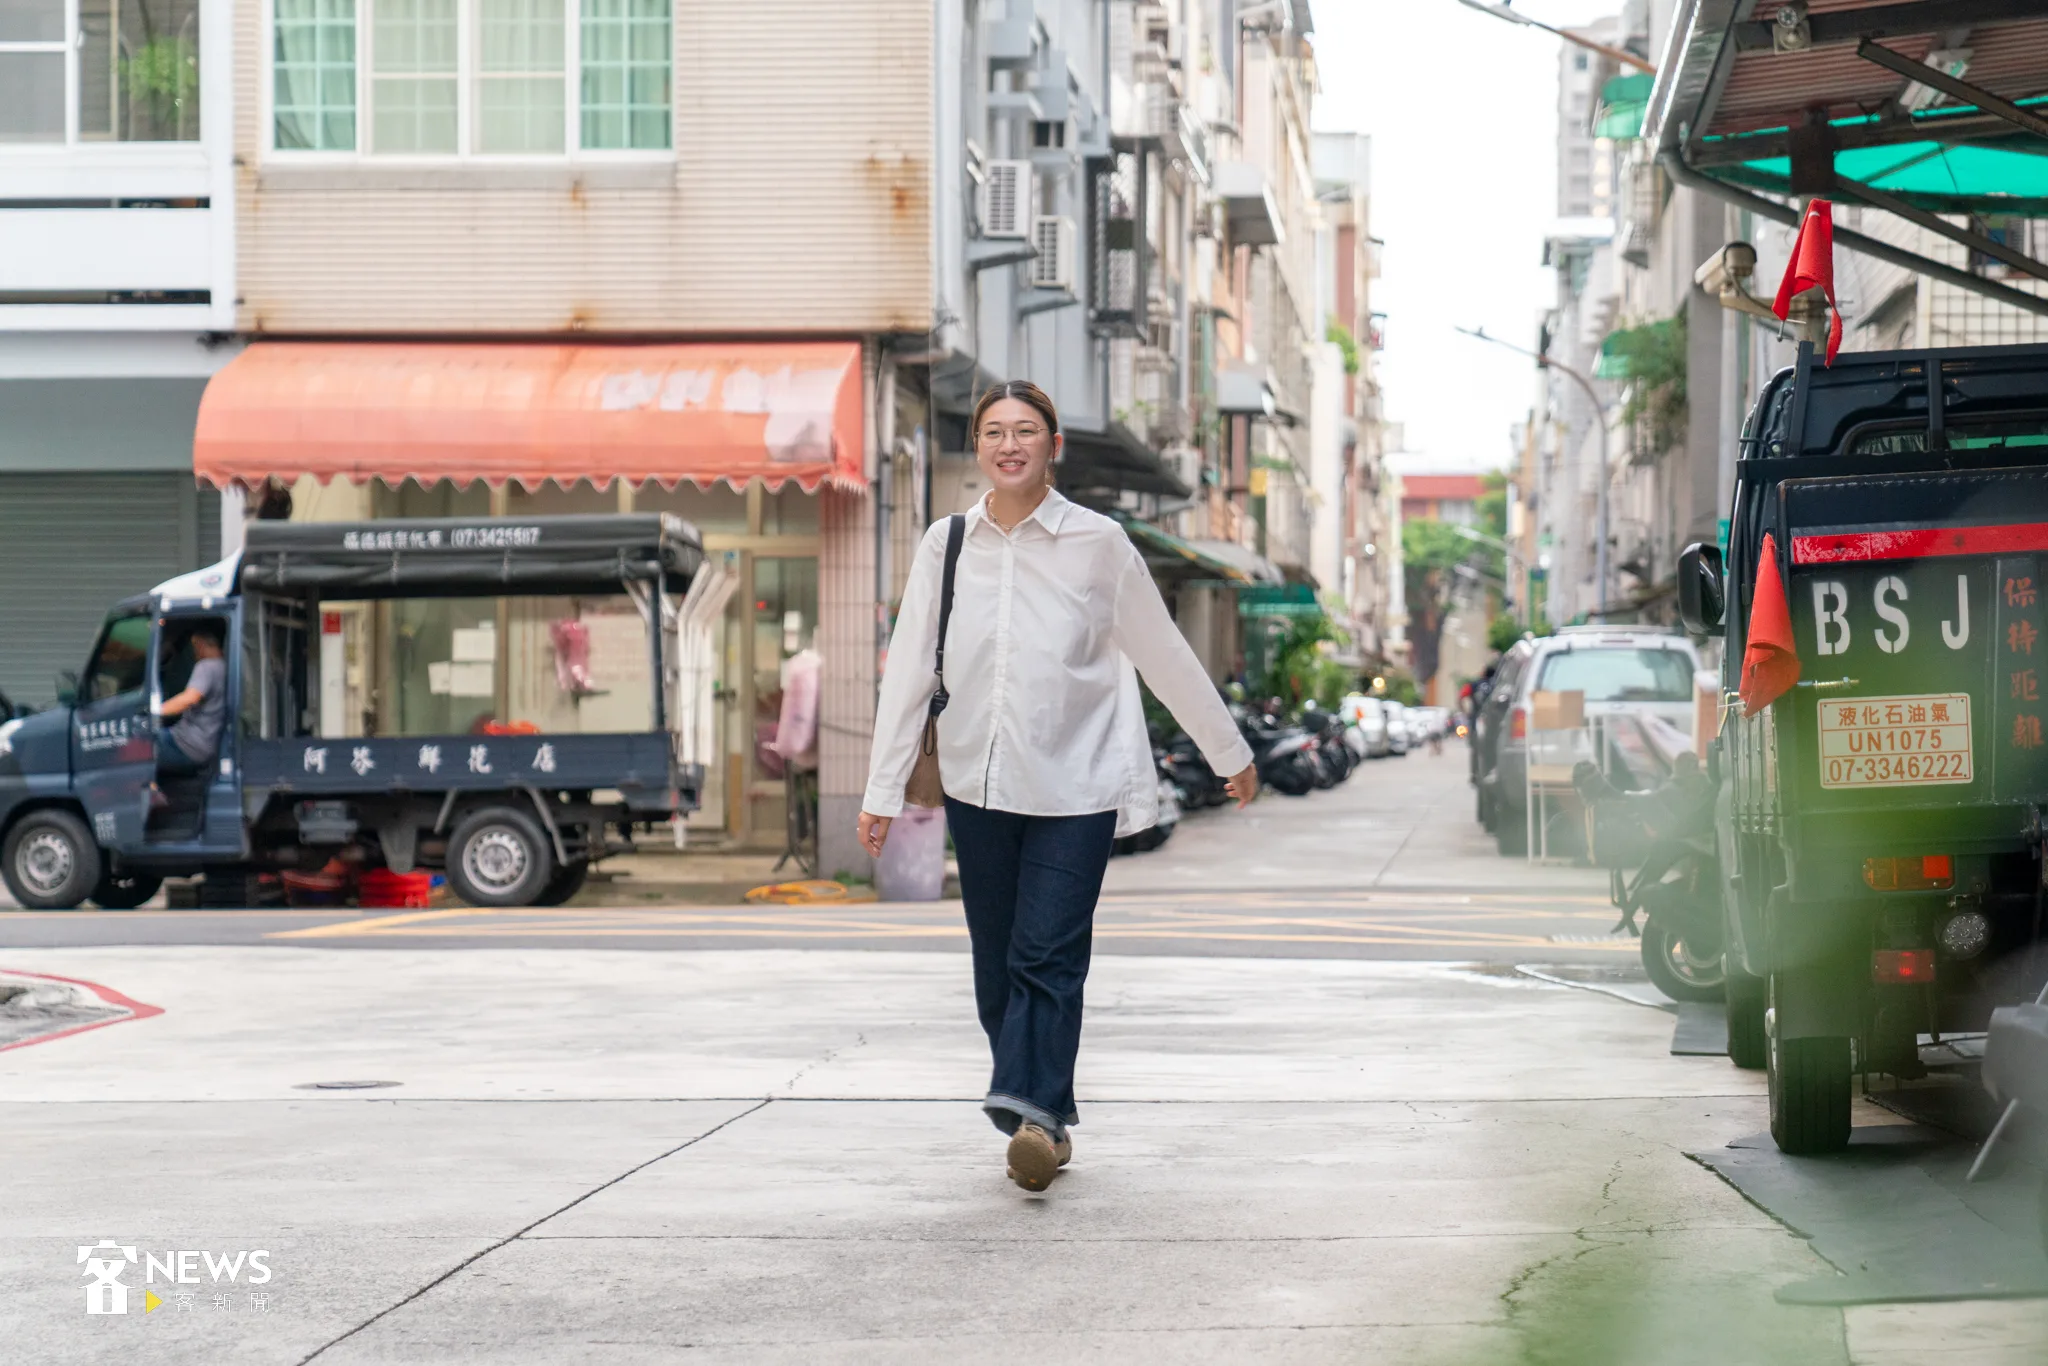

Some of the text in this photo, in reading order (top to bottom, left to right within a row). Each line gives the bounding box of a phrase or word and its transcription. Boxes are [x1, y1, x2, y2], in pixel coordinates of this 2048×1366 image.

[2004, 577, 2044, 750] 保持距離
[1838, 702, 1950, 727] 液化石油氣
[1848, 729, 1942, 753] UN1075
[1828, 754, 1963, 782] 07-3346222
